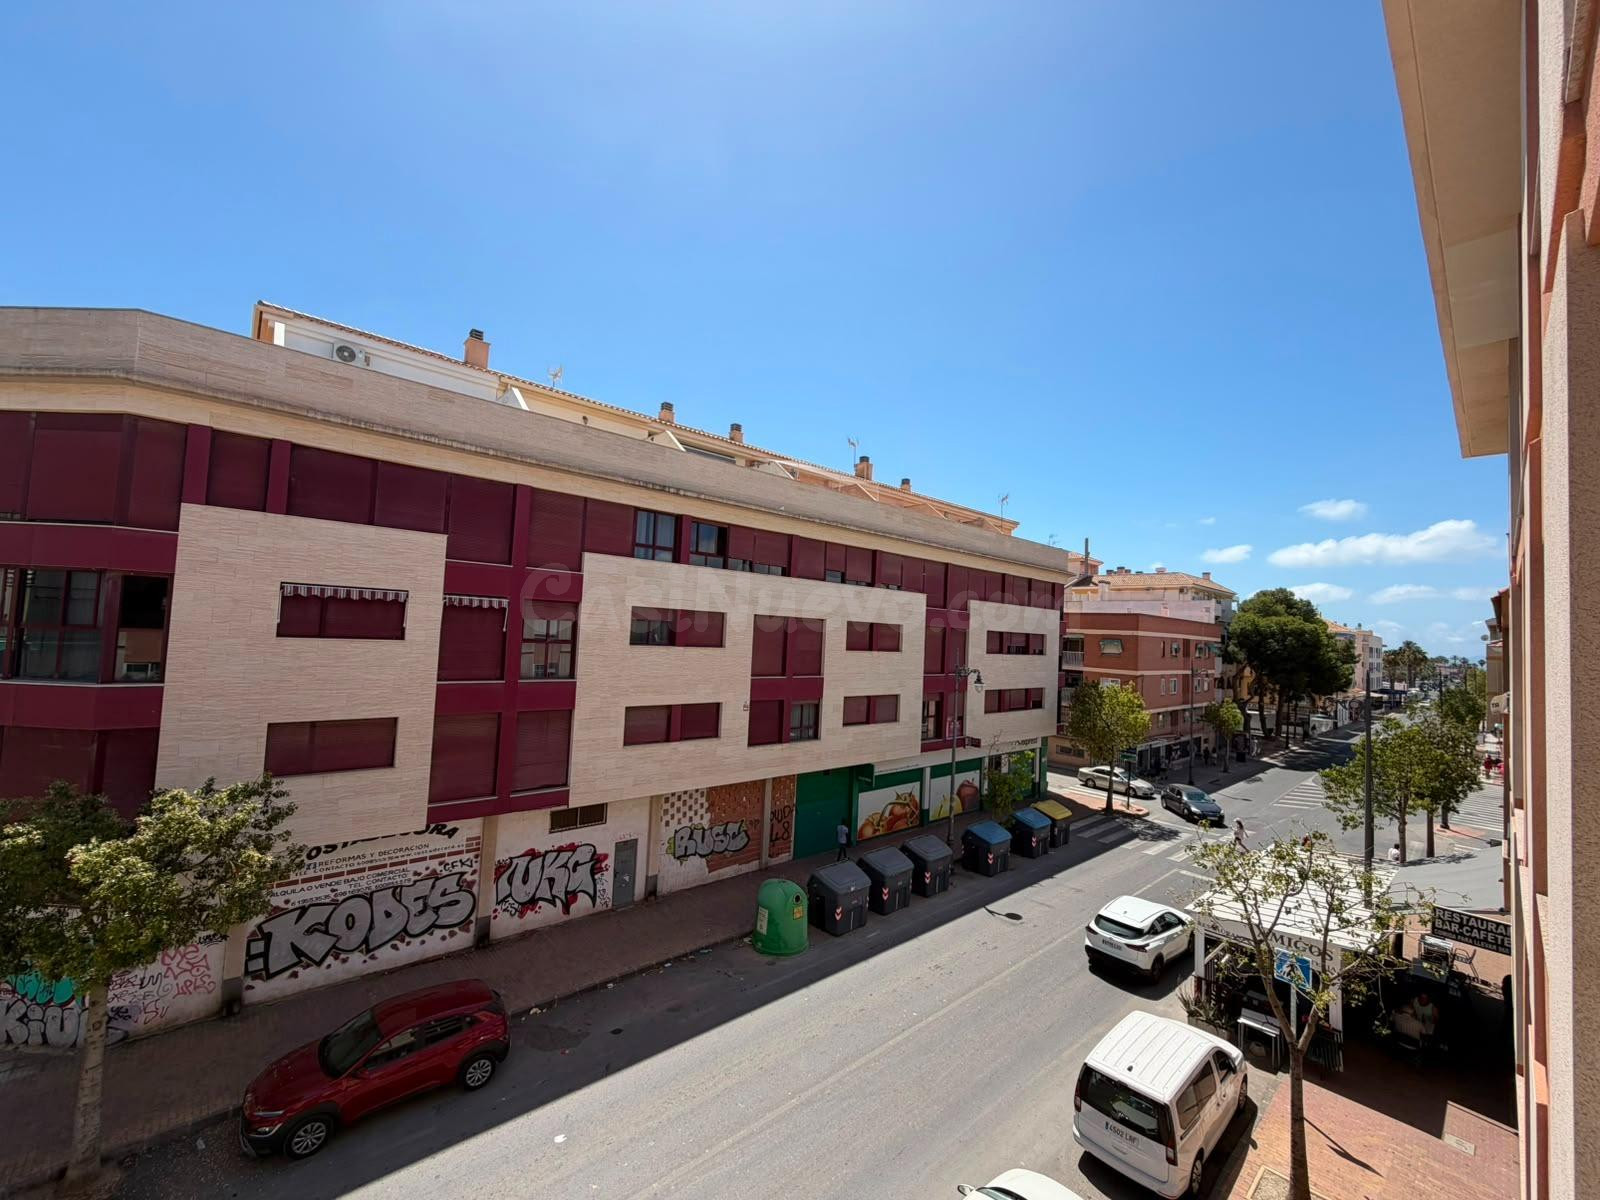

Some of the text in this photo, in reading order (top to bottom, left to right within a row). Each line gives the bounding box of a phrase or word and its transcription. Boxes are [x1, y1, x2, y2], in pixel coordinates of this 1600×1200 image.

[319, 853, 366, 867] REFORMAS
[314, 879, 342, 889] VENDE
[344, 874, 365, 886] BAJO
[366, 867, 410, 880] COMERCIAL
[244, 872, 476, 980] KODES
